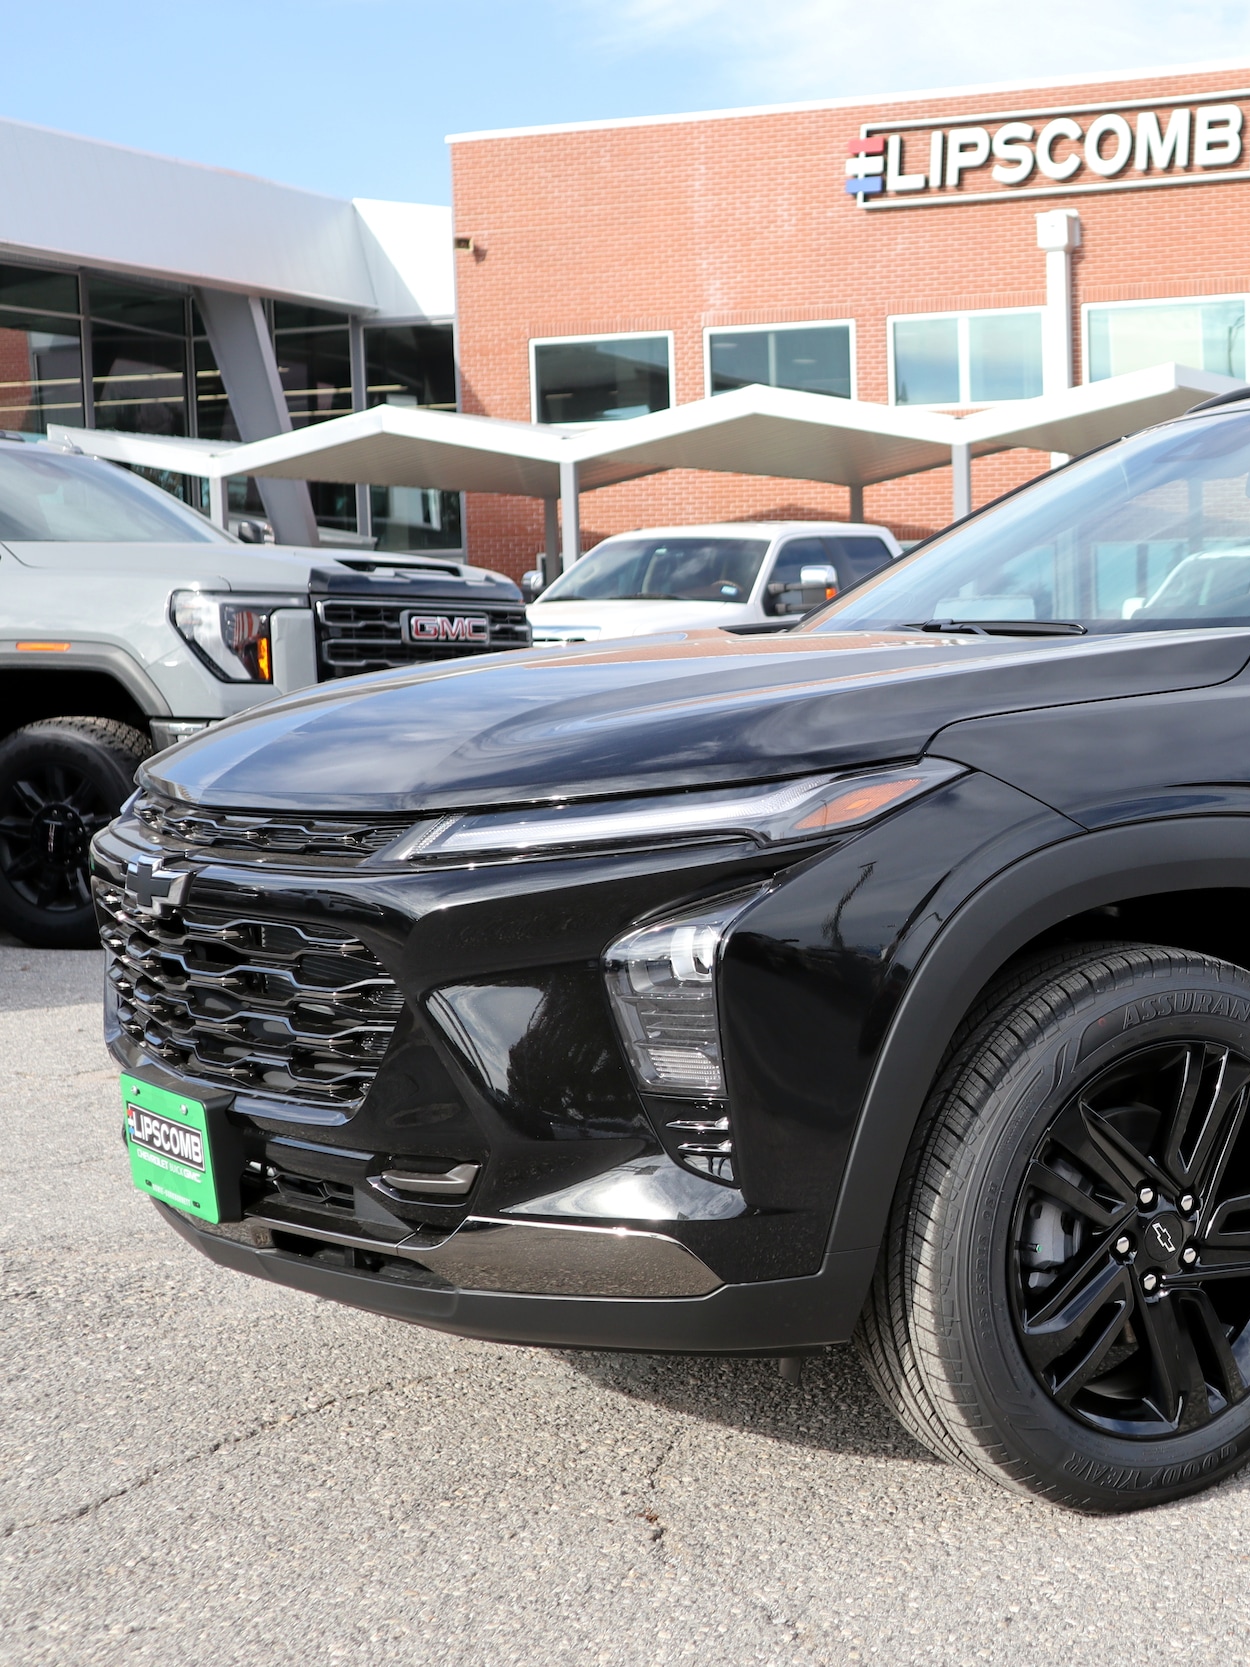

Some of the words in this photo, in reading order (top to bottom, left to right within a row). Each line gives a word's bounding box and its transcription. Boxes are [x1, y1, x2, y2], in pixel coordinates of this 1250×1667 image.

[887, 104, 1243, 192] LIPSCOMB
[411, 616, 488, 641] GMC
[133, 1112, 202, 1163] LIPSCOMB
[1062, 1443, 1238, 1489] GOODYEAR
